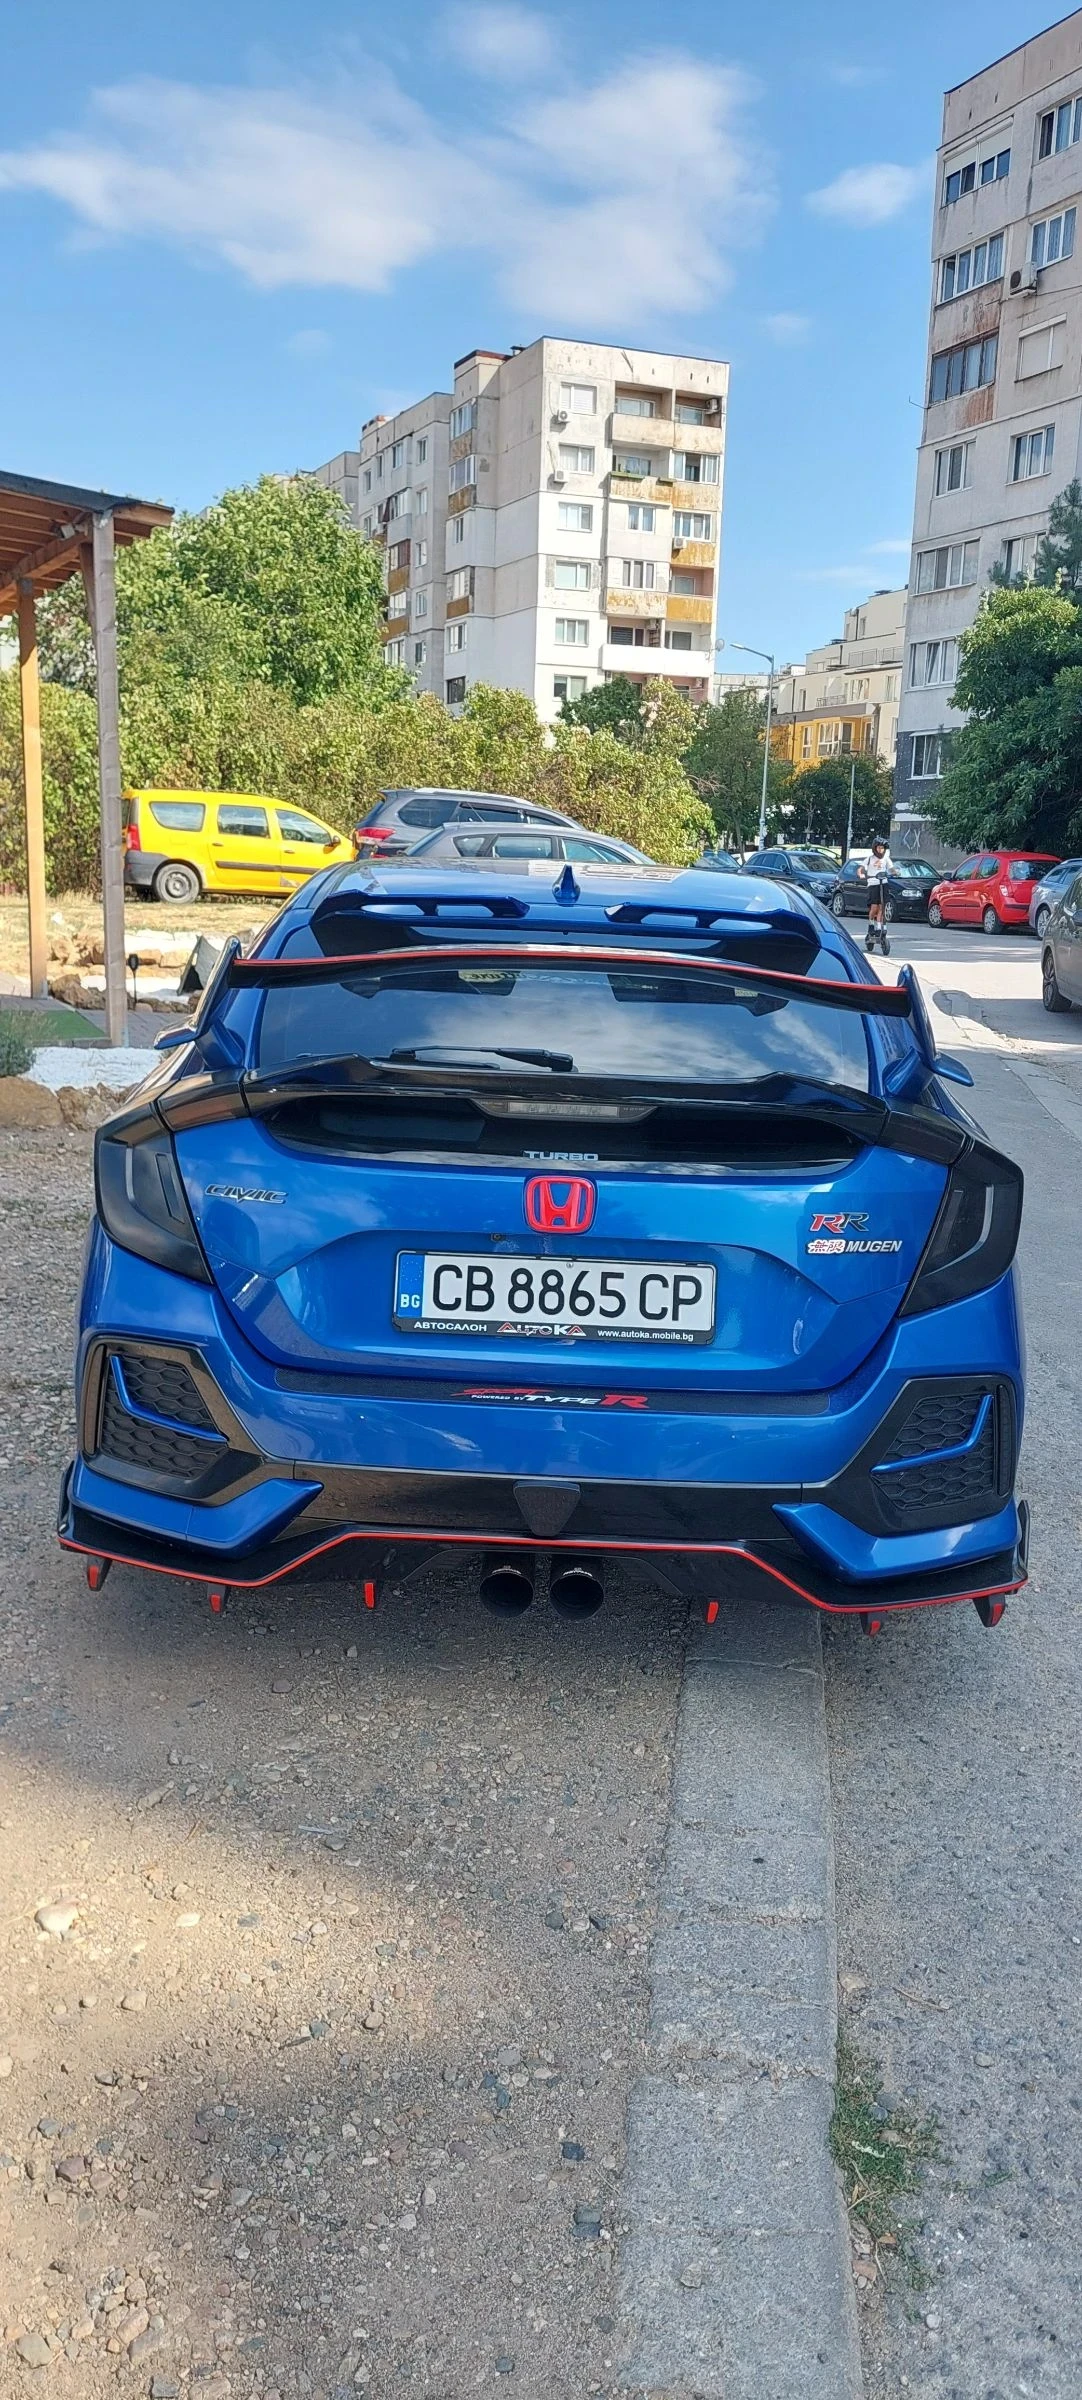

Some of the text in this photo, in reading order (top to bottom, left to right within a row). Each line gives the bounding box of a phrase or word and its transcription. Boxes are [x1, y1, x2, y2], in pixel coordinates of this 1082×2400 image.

[523, 1150, 599, 1161] TURBO
[205, 1184, 287, 1204] CIVIC
[810, 1212, 869, 1233] RR
[845, 1240, 903, 1252] MUGEN
[432, 1264, 702, 1321] CB 8865 CP
[400, 1294, 420, 1308] BG
[414, 1321, 487, 1332] АВТОСАЛОН
[597, 1329, 694, 1342] www.autoka.mobile.bg
[525, 1395, 602, 1406] TYPE
[601, 1394, 650, 1409] R
